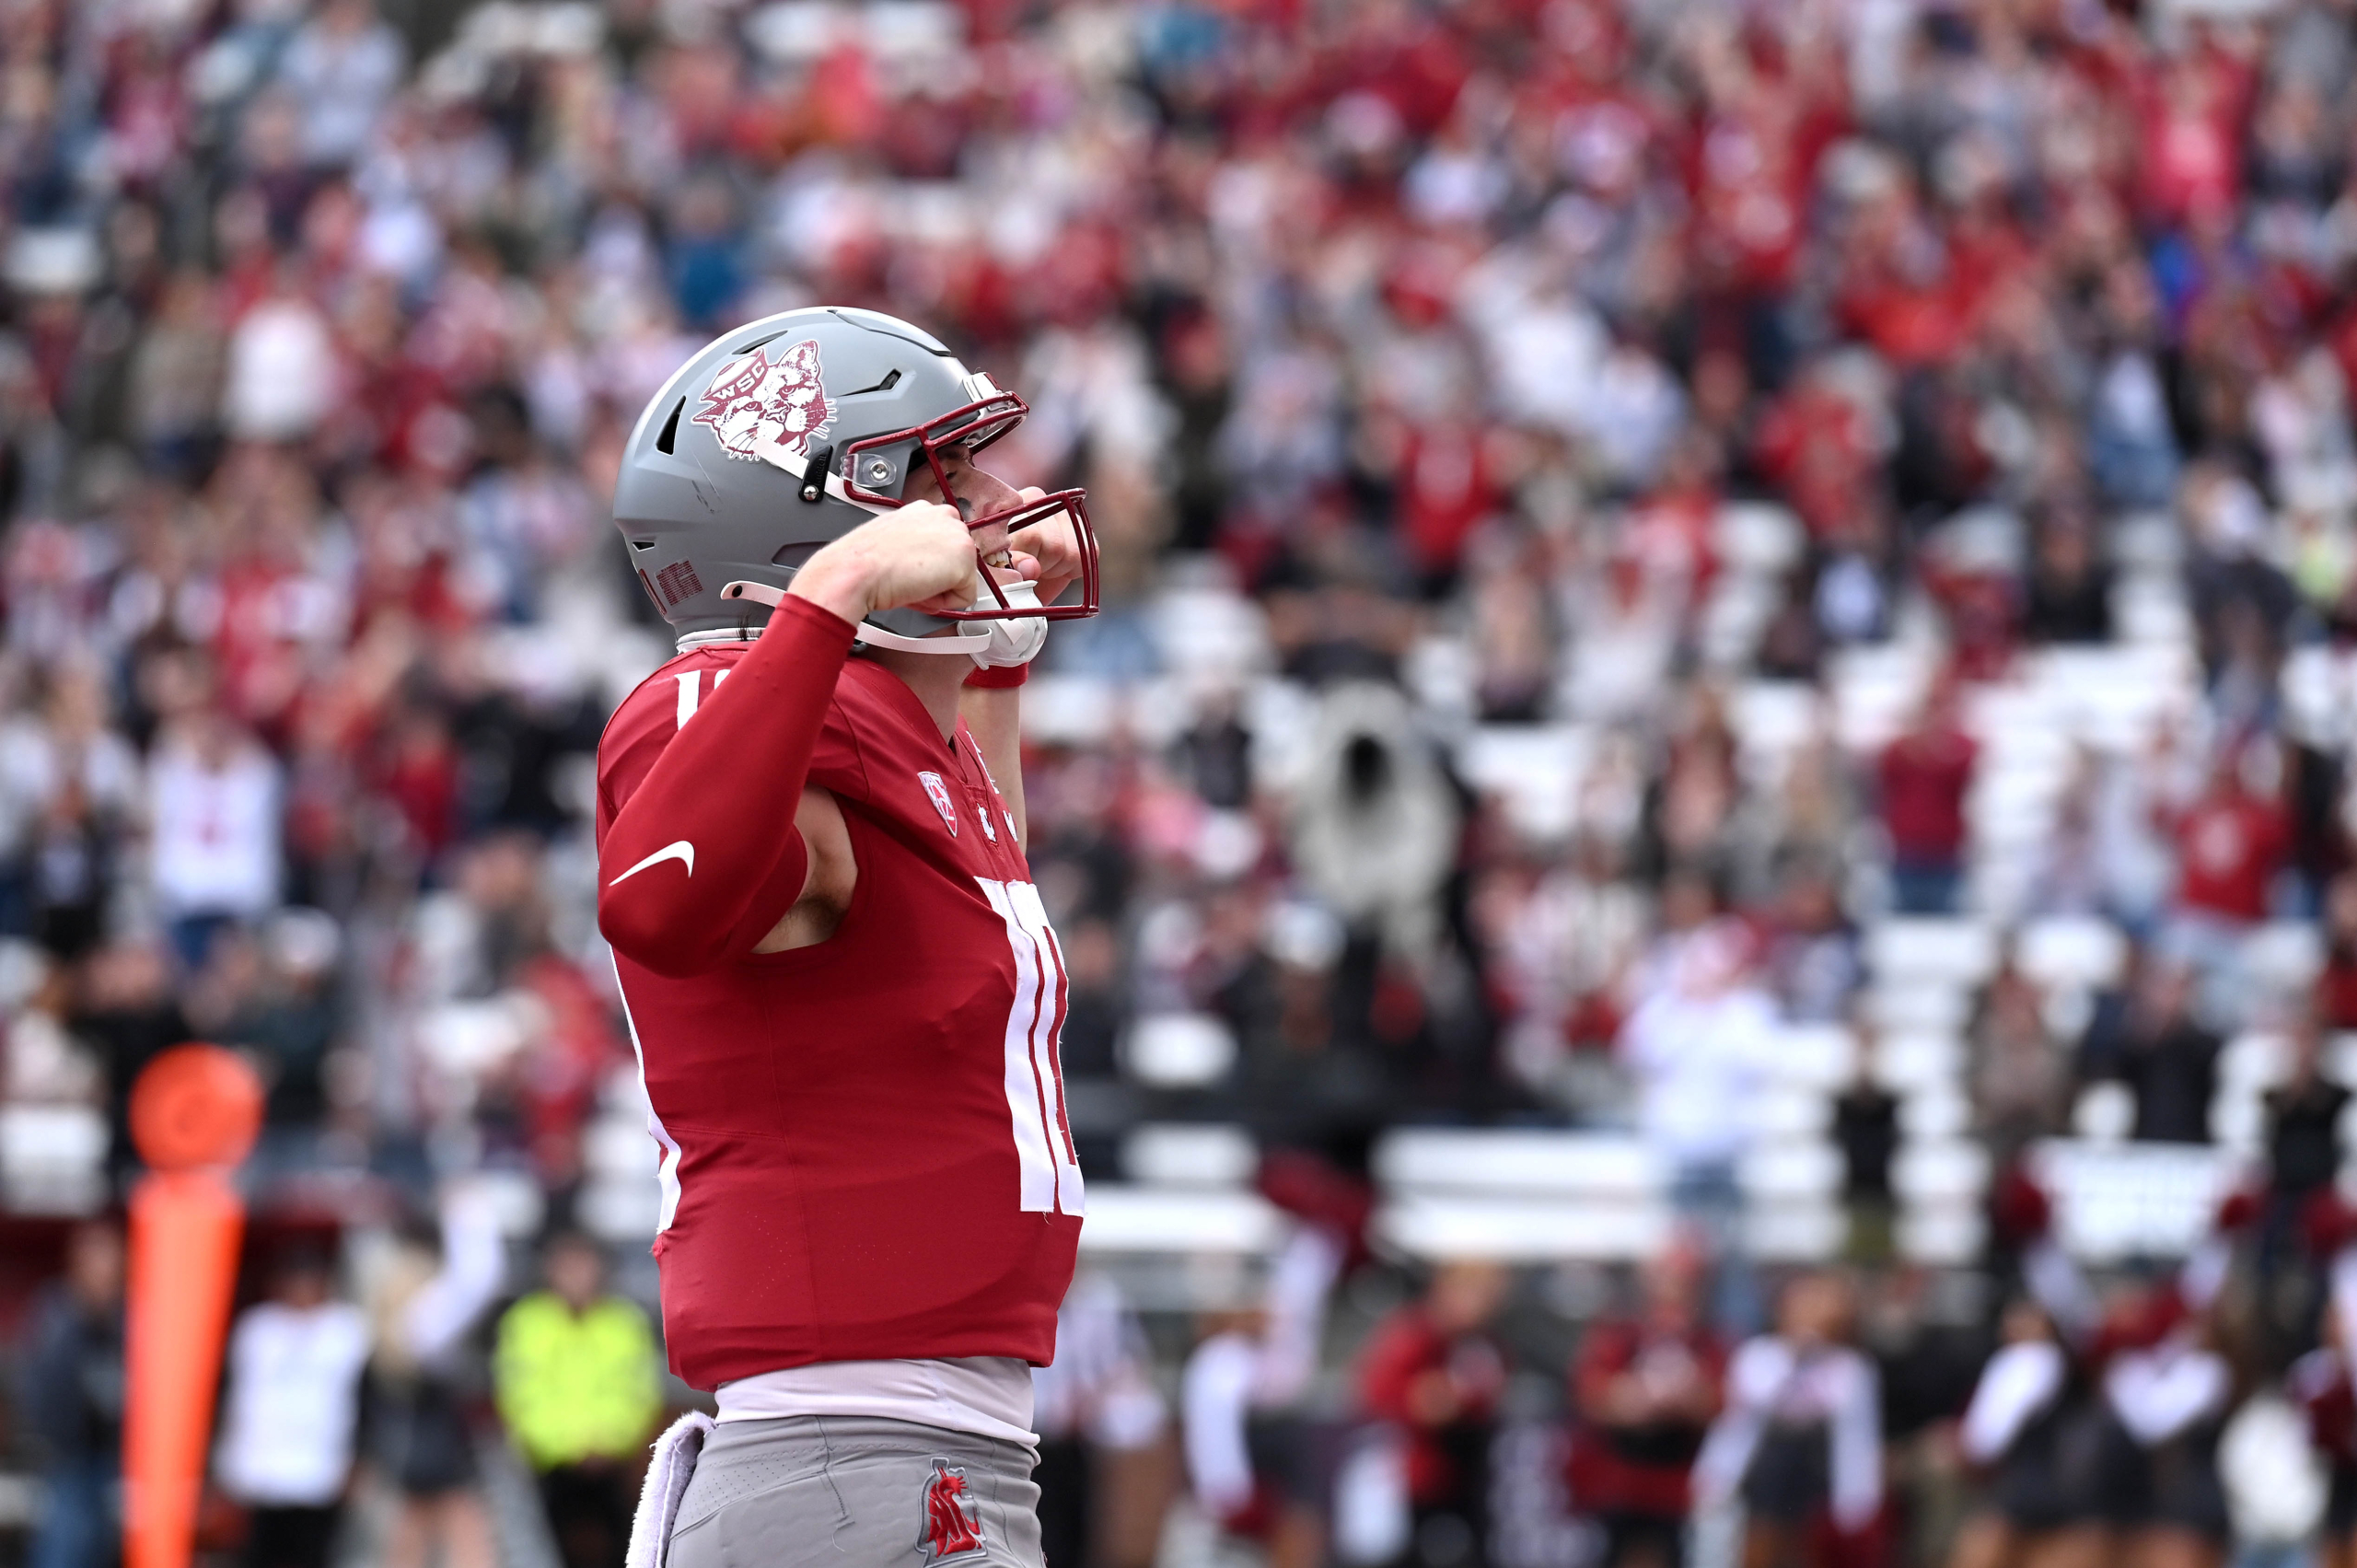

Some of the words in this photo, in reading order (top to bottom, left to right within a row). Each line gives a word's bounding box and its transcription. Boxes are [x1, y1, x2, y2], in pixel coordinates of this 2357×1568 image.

[712, 360, 765, 400] WSC
[674, 668, 732, 731] 1
[973, 876, 1085, 1217] 10
